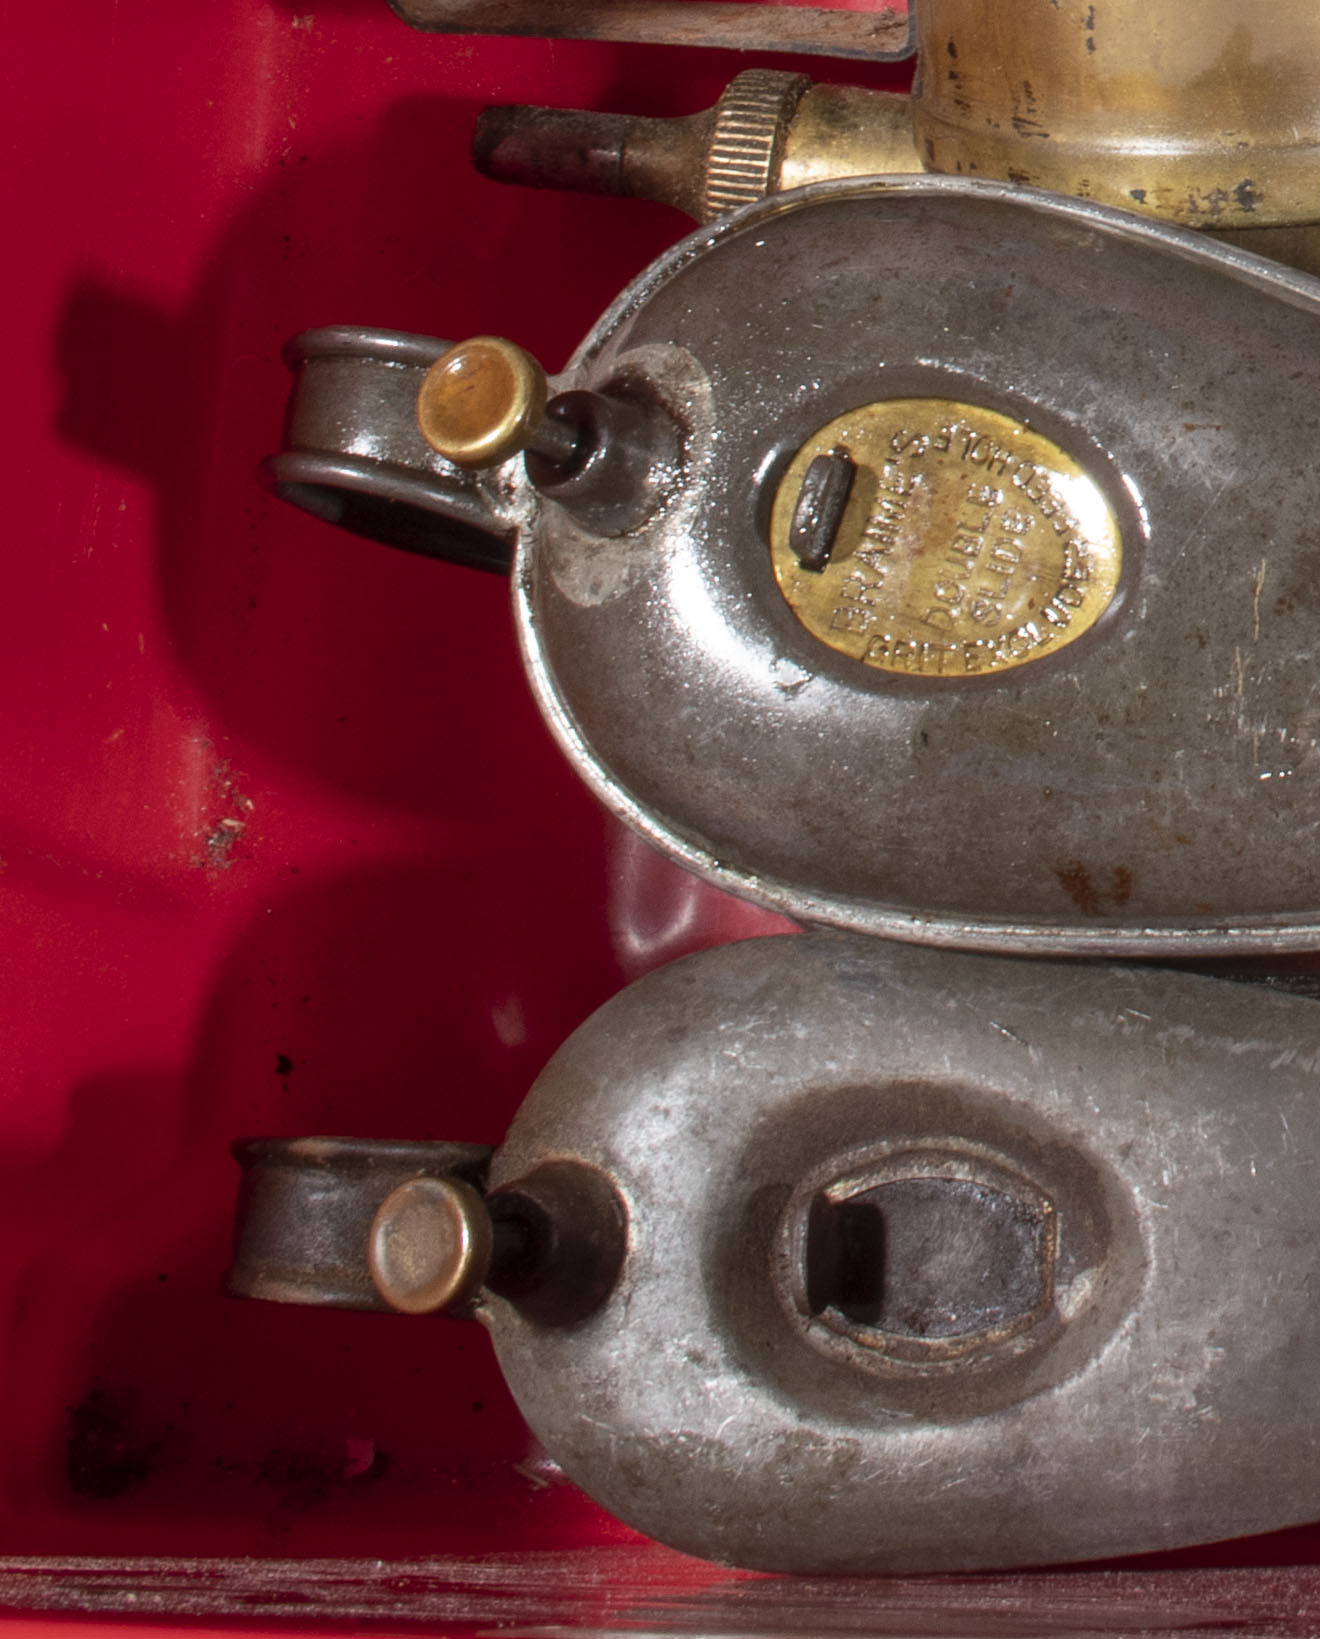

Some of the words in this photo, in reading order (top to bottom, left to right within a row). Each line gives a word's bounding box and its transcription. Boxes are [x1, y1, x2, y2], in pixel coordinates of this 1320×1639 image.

[830, 428, 930, 636] BRAIME'S
[866, 634, 957, 674] GRIT
[932, 422, 1014, 477] HOLE
[922, 482, 1004, 632] DOUBLE
[970, 506, 1036, 626] SLIDE
